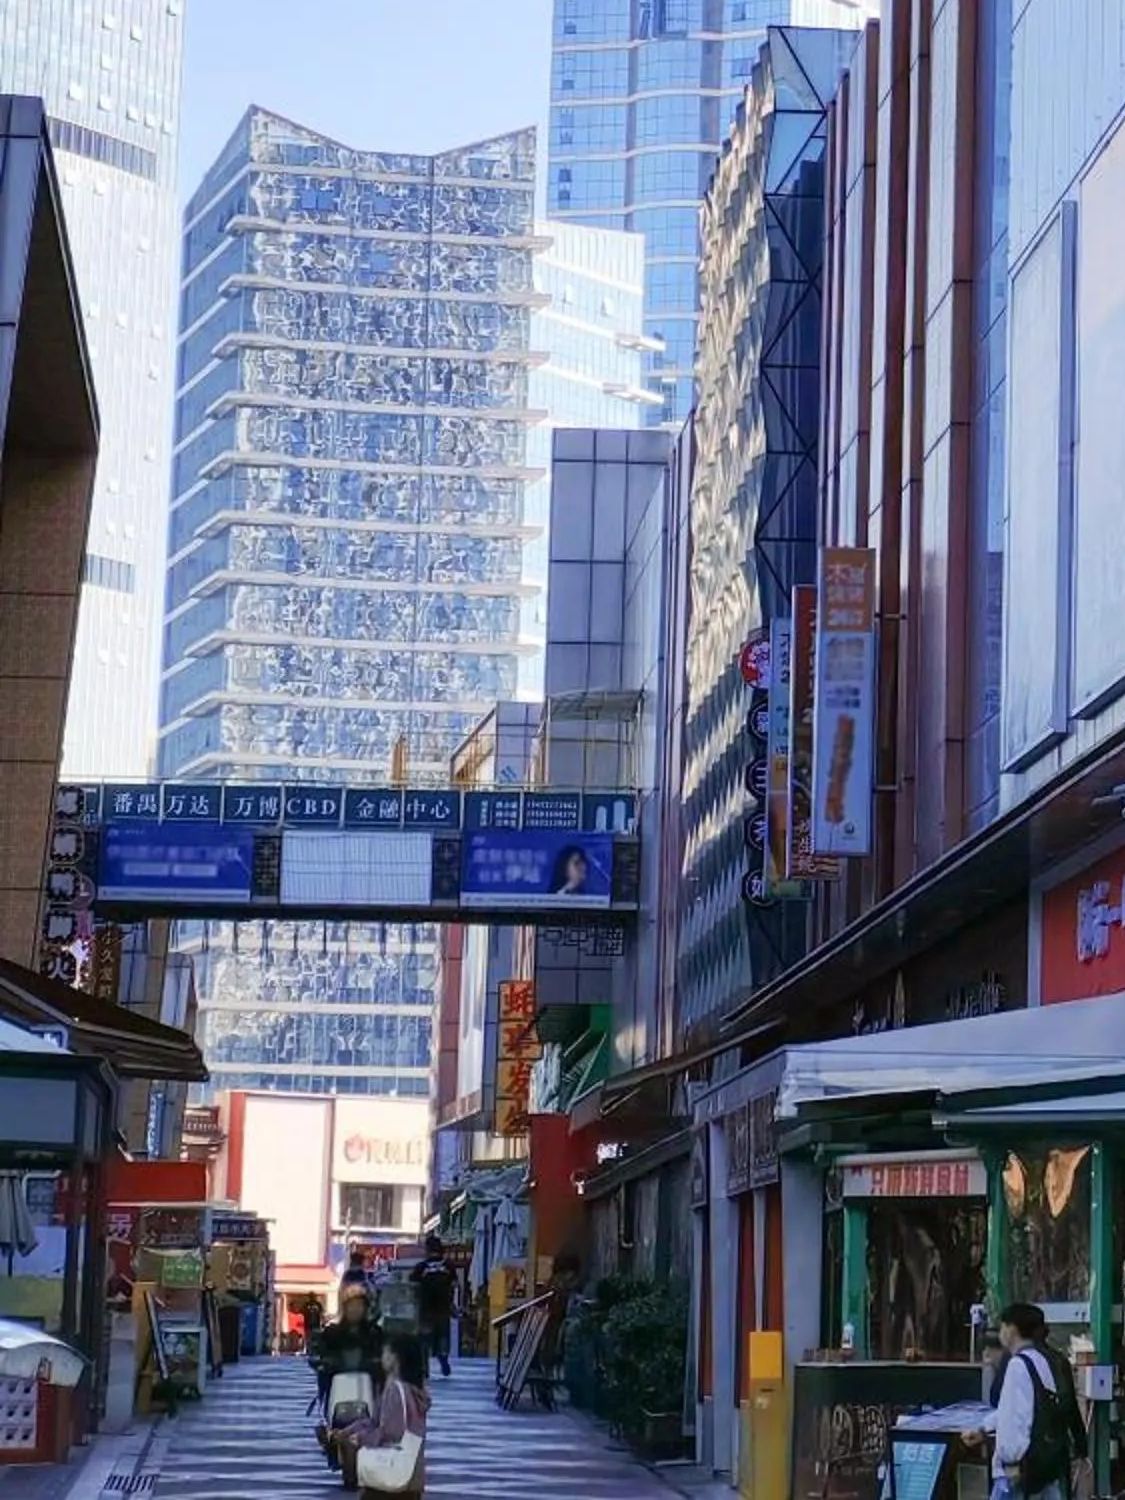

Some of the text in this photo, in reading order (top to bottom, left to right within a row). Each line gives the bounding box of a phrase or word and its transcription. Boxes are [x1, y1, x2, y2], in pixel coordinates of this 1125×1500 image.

[113, 792, 451, 819] 番禺万达 万博CBD 金融中心
